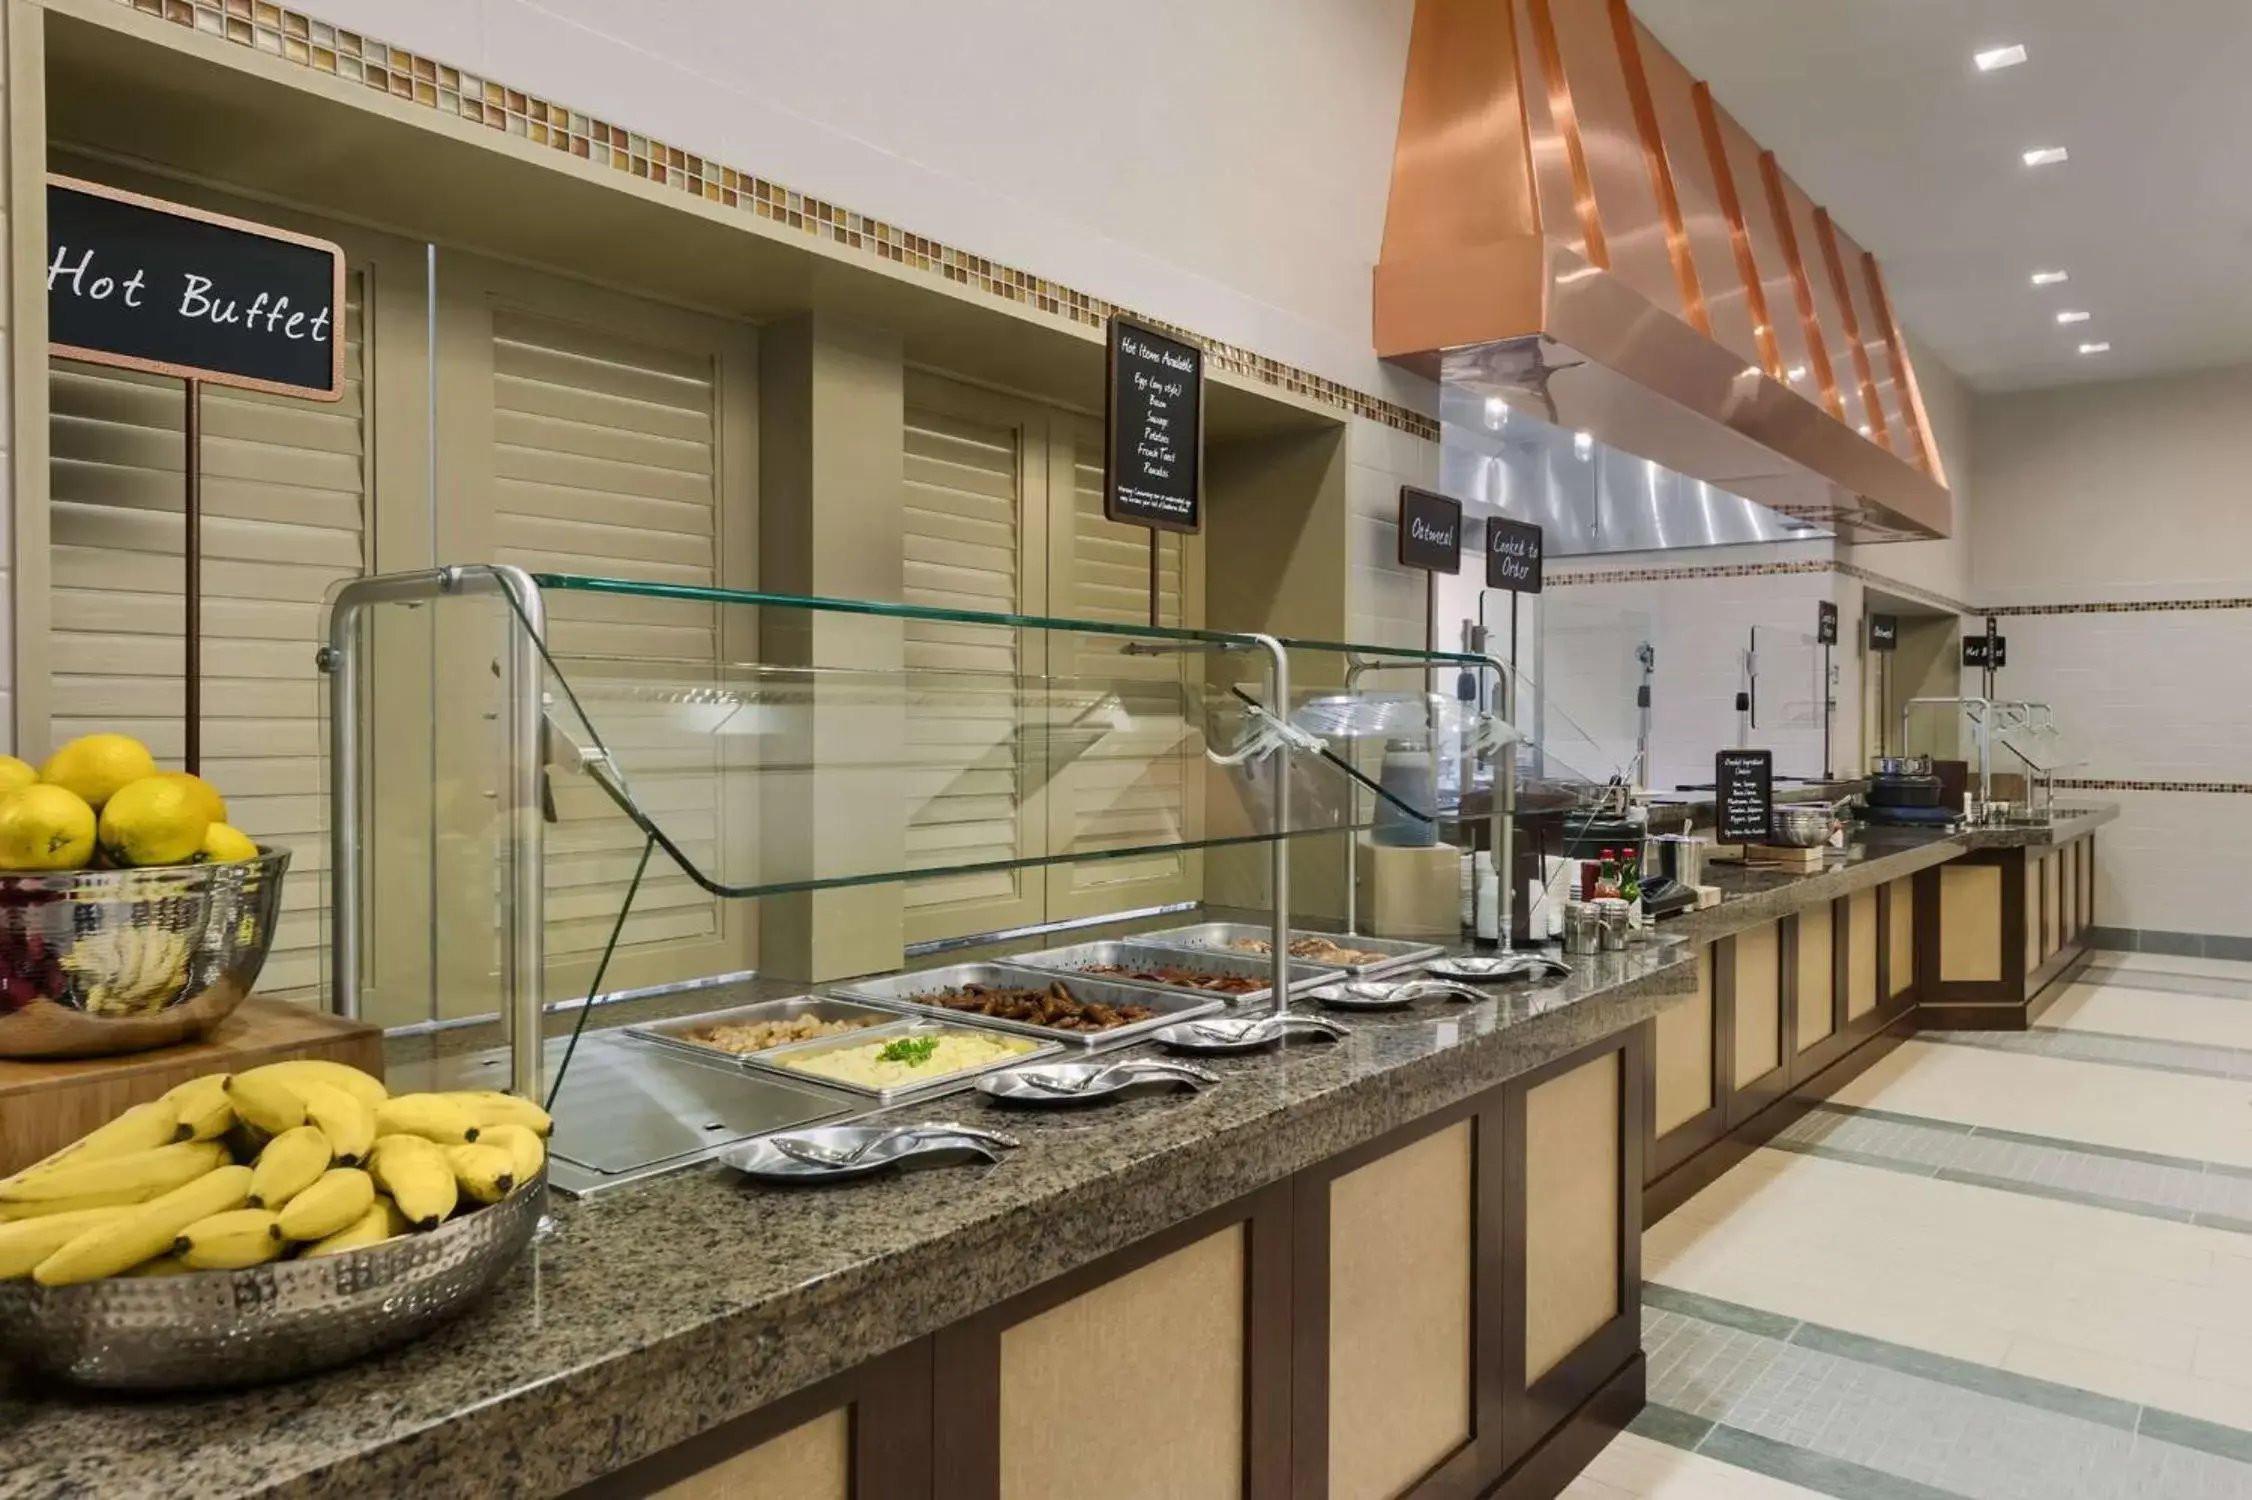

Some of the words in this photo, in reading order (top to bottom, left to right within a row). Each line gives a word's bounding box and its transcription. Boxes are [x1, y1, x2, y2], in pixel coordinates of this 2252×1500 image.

[47, 245, 145, 307] Hot
[178, 273, 330, 342] Buffet
[1121, 336, 1137, 355] Hot
[1139, 343, 1160, 363] Items
[1411, 517, 1454, 546] Oatmeal
[1493, 530, 1525, 557] Cooked
[1528, 540, 1539, 559] to
[1502, 556, 1530, 580] Order
